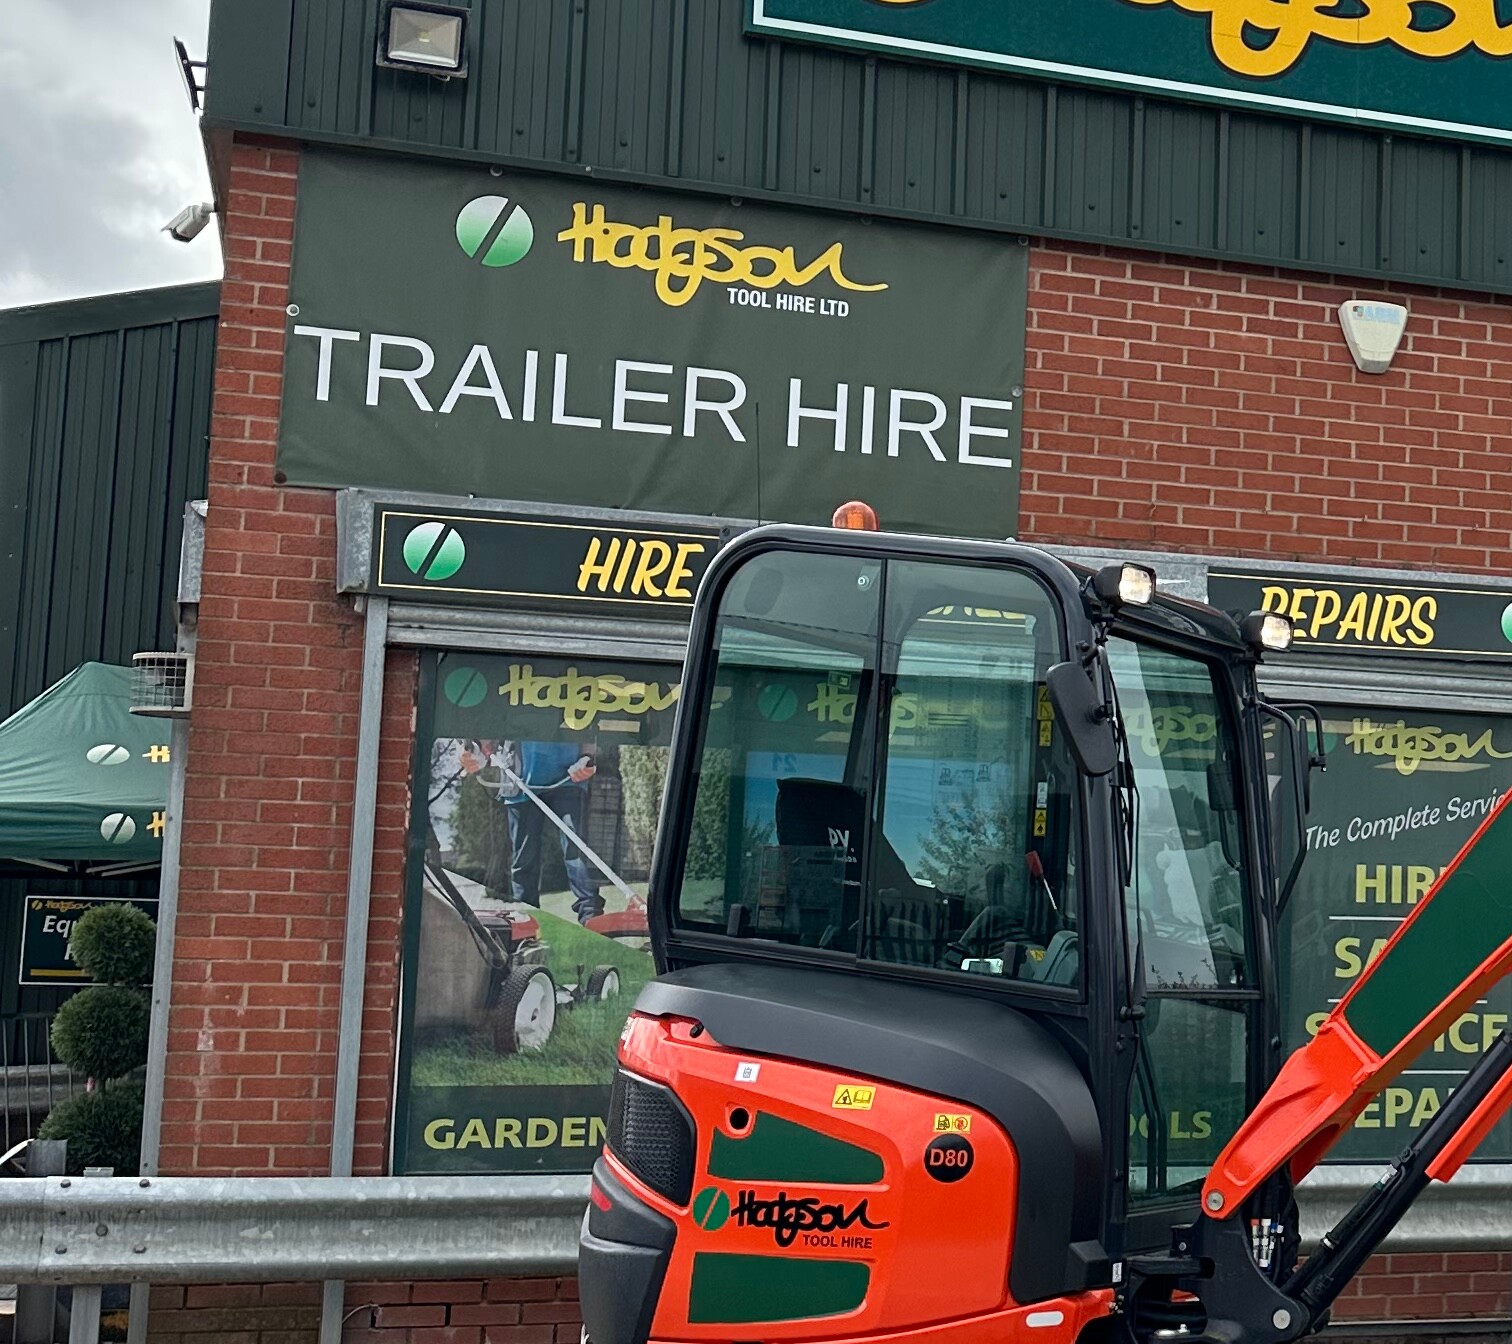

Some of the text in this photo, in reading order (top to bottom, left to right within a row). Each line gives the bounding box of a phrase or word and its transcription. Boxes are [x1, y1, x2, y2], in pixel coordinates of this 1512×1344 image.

[557, 202, 888, 306] Hodgson
[728, 288, 849, 318] TOOL HIRE LTD
[294, 325, 1013, 468] TRAILER HIRE
[577, 537, 705, 597] HIRE
[1262, 586, 1437, 645] REPAIRS
[1306, 826, 1340, 851] The
[1347, 804, 1441, 841] Complete
[1356, 865, 1447, 904] HIR
[929, 1148, 969, 1168] D80
[731, 1190, 890, 1247] Hodgson
[803, 1234, 873, 1249] TOOL HIRE
